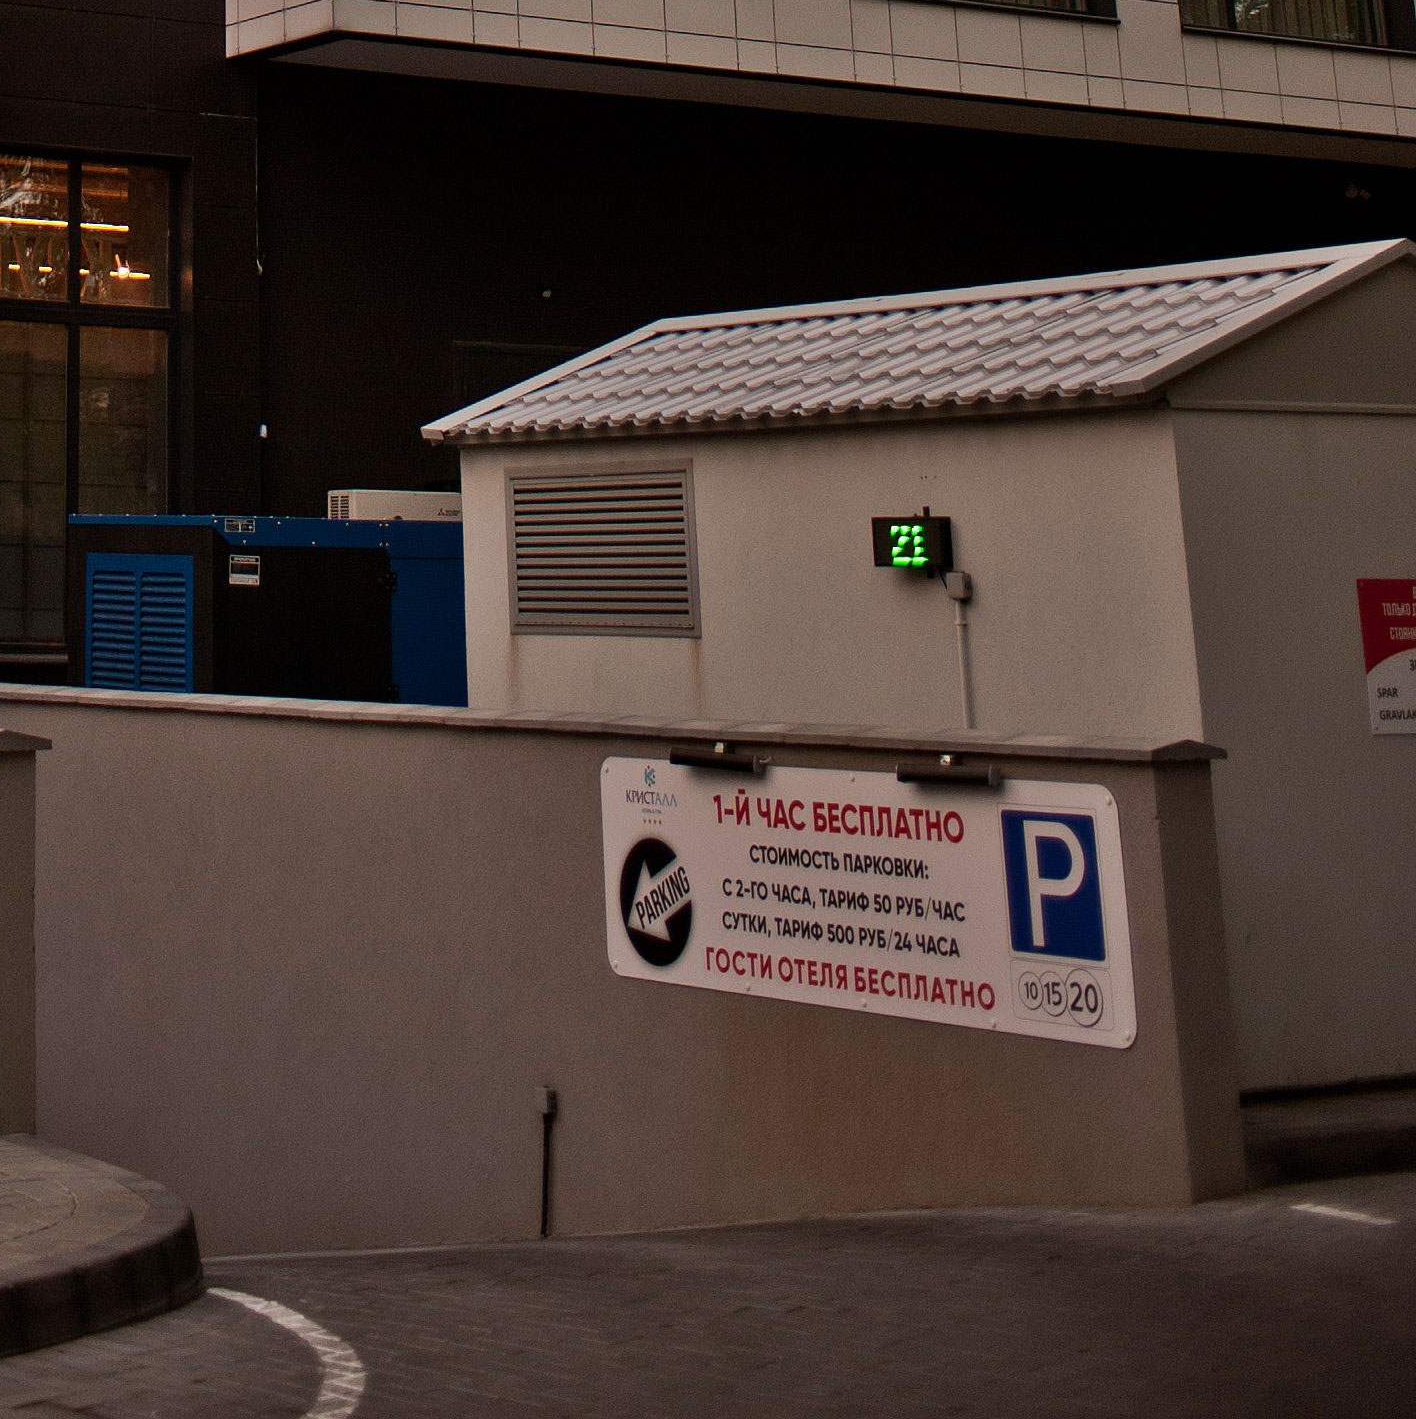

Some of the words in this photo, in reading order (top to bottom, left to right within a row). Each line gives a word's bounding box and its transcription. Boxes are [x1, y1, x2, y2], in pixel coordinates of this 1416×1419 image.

[1376, 687, 1399, 699] SPAR
[713, 789, 751, 826] 1-Й
[757, 797, 806, 832] ЧАС
[812, 801, 965, 844] БЕСПЛАТНО
[749, 844, 840, 871] СТОИМОСТЬ
[843, 853, 929, 880] ПАРКОВКИ:
[1022, 819, 1085, 948] P
[635, 866, 691, 930] PARKING
[722, 878, 733, 897] С
[736, 879, 768, 901] 2-ГО
[771, 884, 816, 908] ЧАСА,
[819, 888, 870, 912] ТАРИФ
[873, 893, 892, 914] 50
[896, 896, 966, 922] РУБ/ЧАС
[722, 911, 771, 938] СУТКИ,
[774, 917, 823, 941] ТАРИФ
[827, 924, 855, 945] 500
[858, 926, 912, 952] РУБ/24
[915, 932, 961, 958] ЧАСА
[705, 946, 773, 980] ГОСТИ
[777, 956, 849, 991] ОТЕЛЯ
[854, 966, 996, 1011] БЕСПЛАТНО
[1024, 981, 1038, 1000] 10
[1044, 981, 1062, 1006] 15
[1070, 981, 1099, 1013] 20
